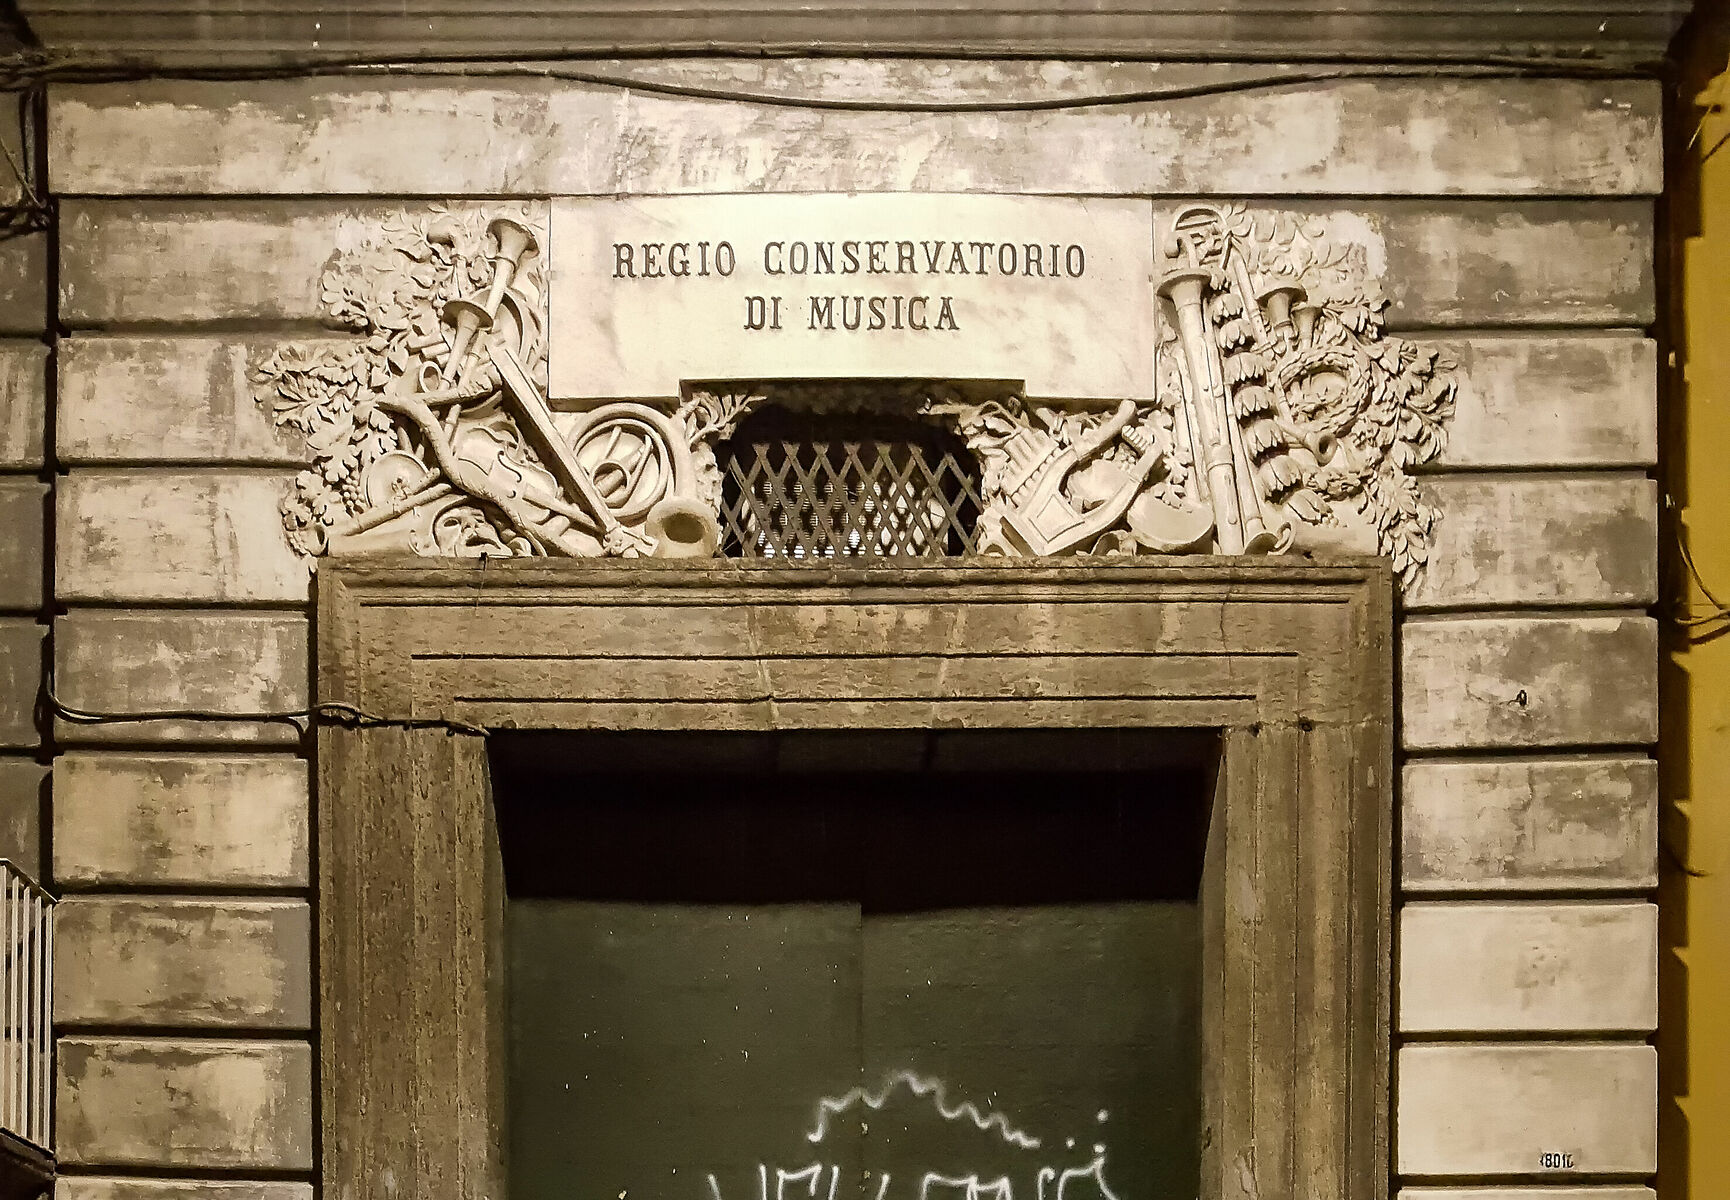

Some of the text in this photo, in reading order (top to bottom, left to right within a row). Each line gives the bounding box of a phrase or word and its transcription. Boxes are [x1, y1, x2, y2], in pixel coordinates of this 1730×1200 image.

[612, 240, 1086, 279] REGIO CONSERVATORIO
[743, 294, 961, 331] DI MUSICA
